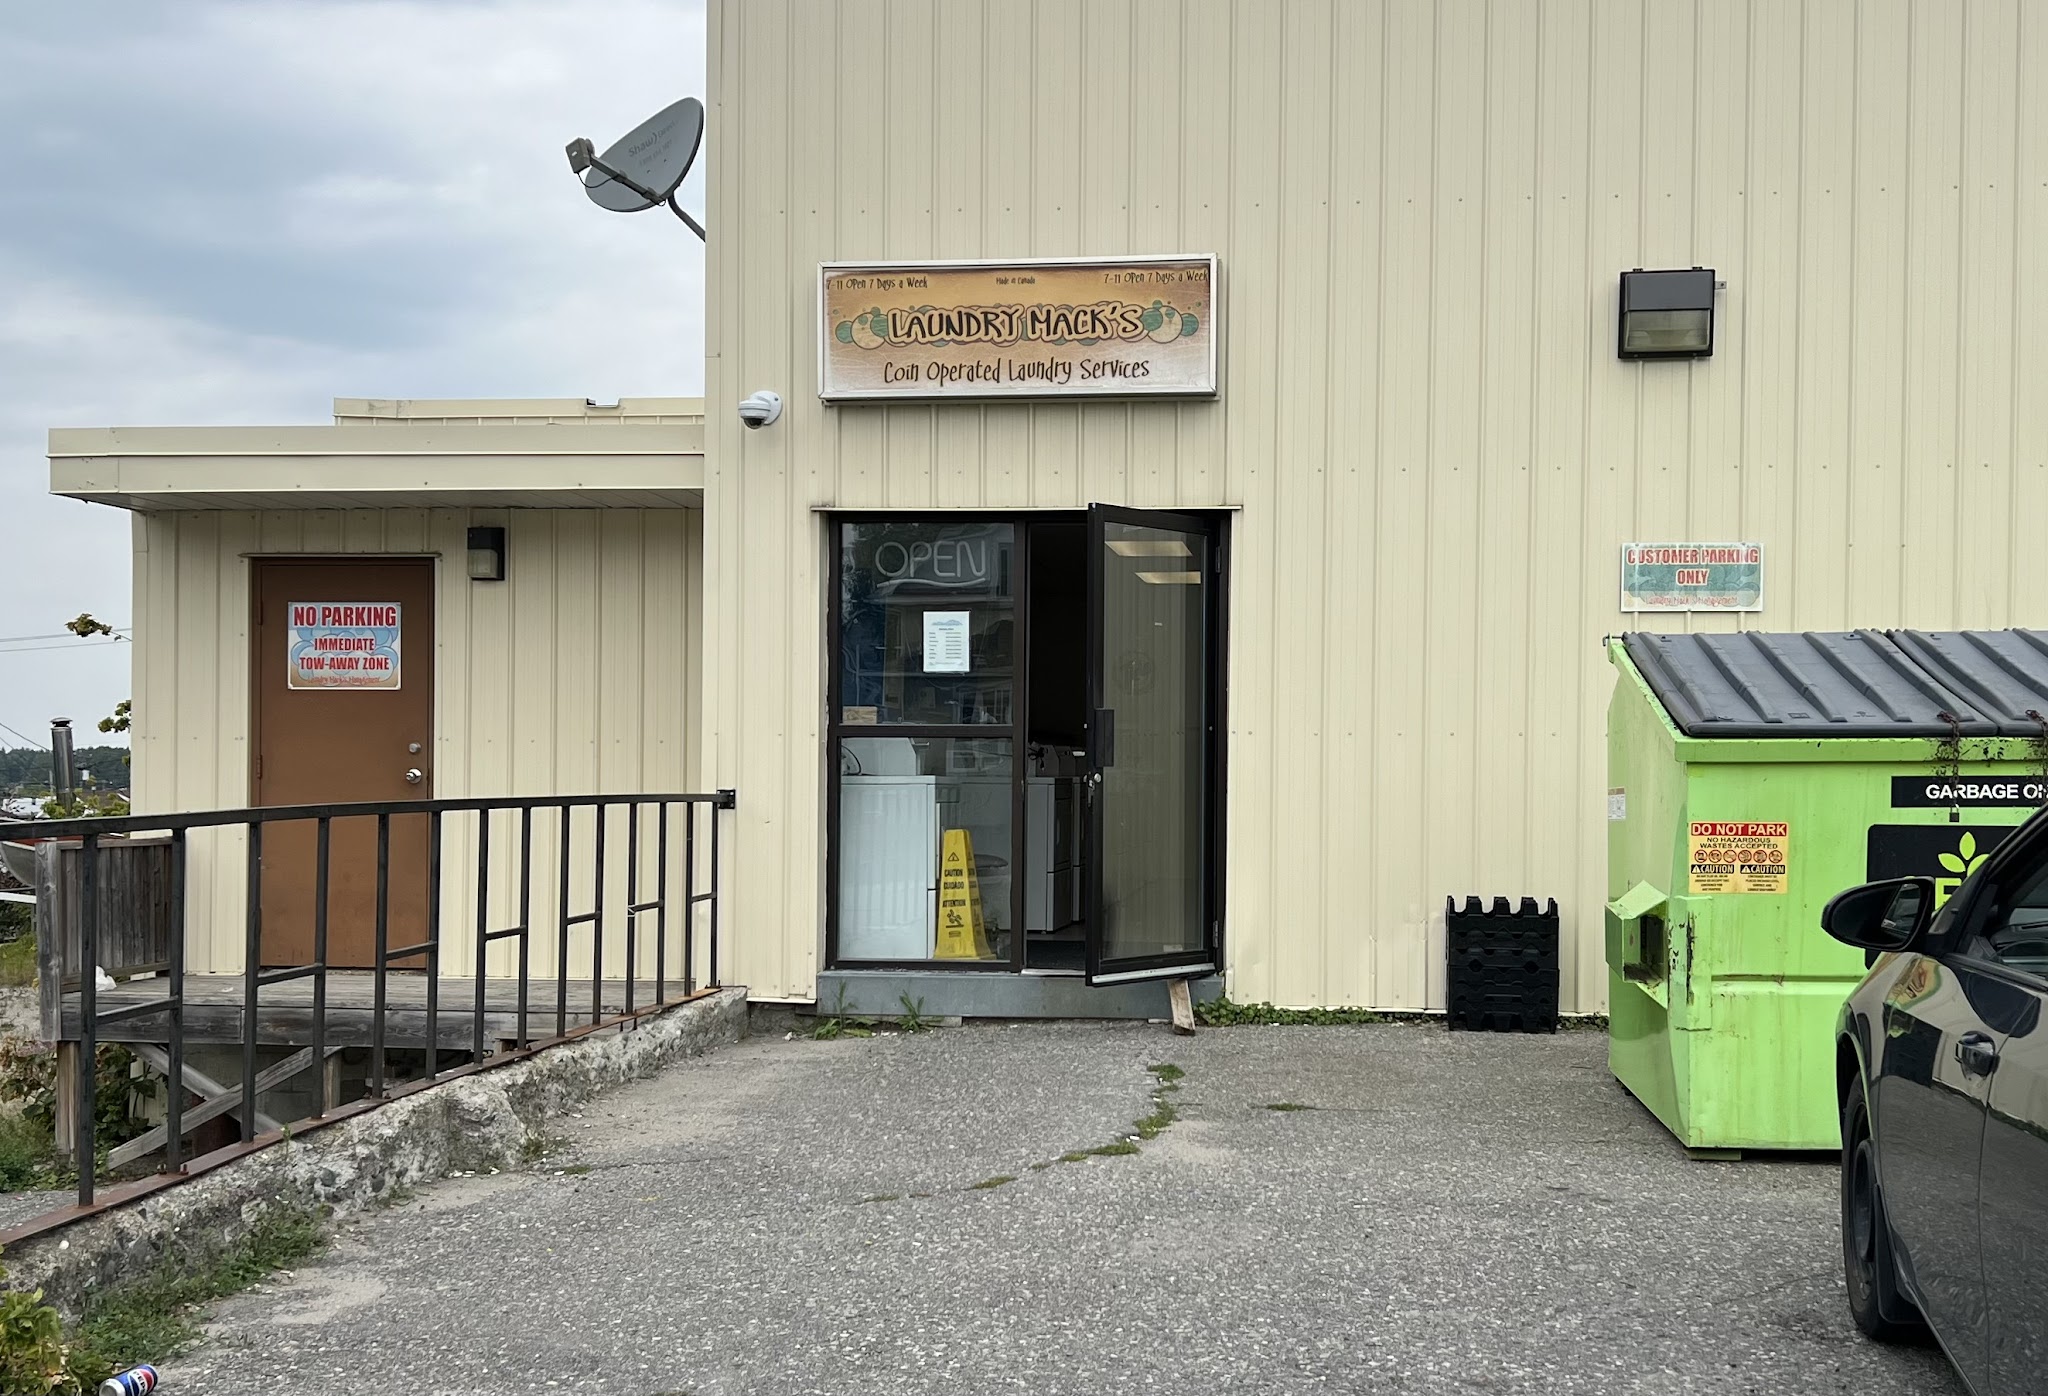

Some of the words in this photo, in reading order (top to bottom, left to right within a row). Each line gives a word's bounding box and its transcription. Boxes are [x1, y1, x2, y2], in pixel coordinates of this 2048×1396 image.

[996, 277, 1009, 285] Made
[1017, 276, 1035, 285] Canada
[1104, 273, 1121, 284] 7-11
[1148, 273, 1153, 283] 7
[1156, 272, 1175, 284] Days
[1178, 274, 1183, 283] a
[1186, 270, 1208, 282] Week
[826, 279, 843, 290] 7-11
[869, 279, 874, 289] 7
[877, 278, 895, 290] Days
[899, 281, 903, 289] a
[906, 278, 928, 289] Week
[890, 306, 1020, 340] LAUNDRY
[1027, 301, 1142, 338] MACK'S
[884, 361, 919, 384] Coin
[927, 358, 1001, 387] Operated
[1008, 356, 1072, 385] Laundry
[1080, 357, 1150, 381] Services
[875, 541, 986, 578] OPEN
[1627, 549, 1699, 564] CUSTOMER
[1701, 549, 1759, 564] PARKING
[1677, 570, 1709, 585] ONLY
[294, 606, 317, 627] NO
[321, 606, 397, 627] PARKING
[314, 638, 375, 651] IMMEDIATE
[299, 657, 360, 670] TOW-AWAY
[363, 657, 390, 670] ZONE
[1925, 784, 2019, 799] GARBAGE
[1692, 823, 1712, 835] DO
[1716, 823, 1744, 835] NOT
[1748, 824, 1786, 836] PARK
[944, 868, 963, 877] CAUTION
[1700, 865, 1734, 874] CAUTION
[1750, 865, 1785, 874] CAUTION
